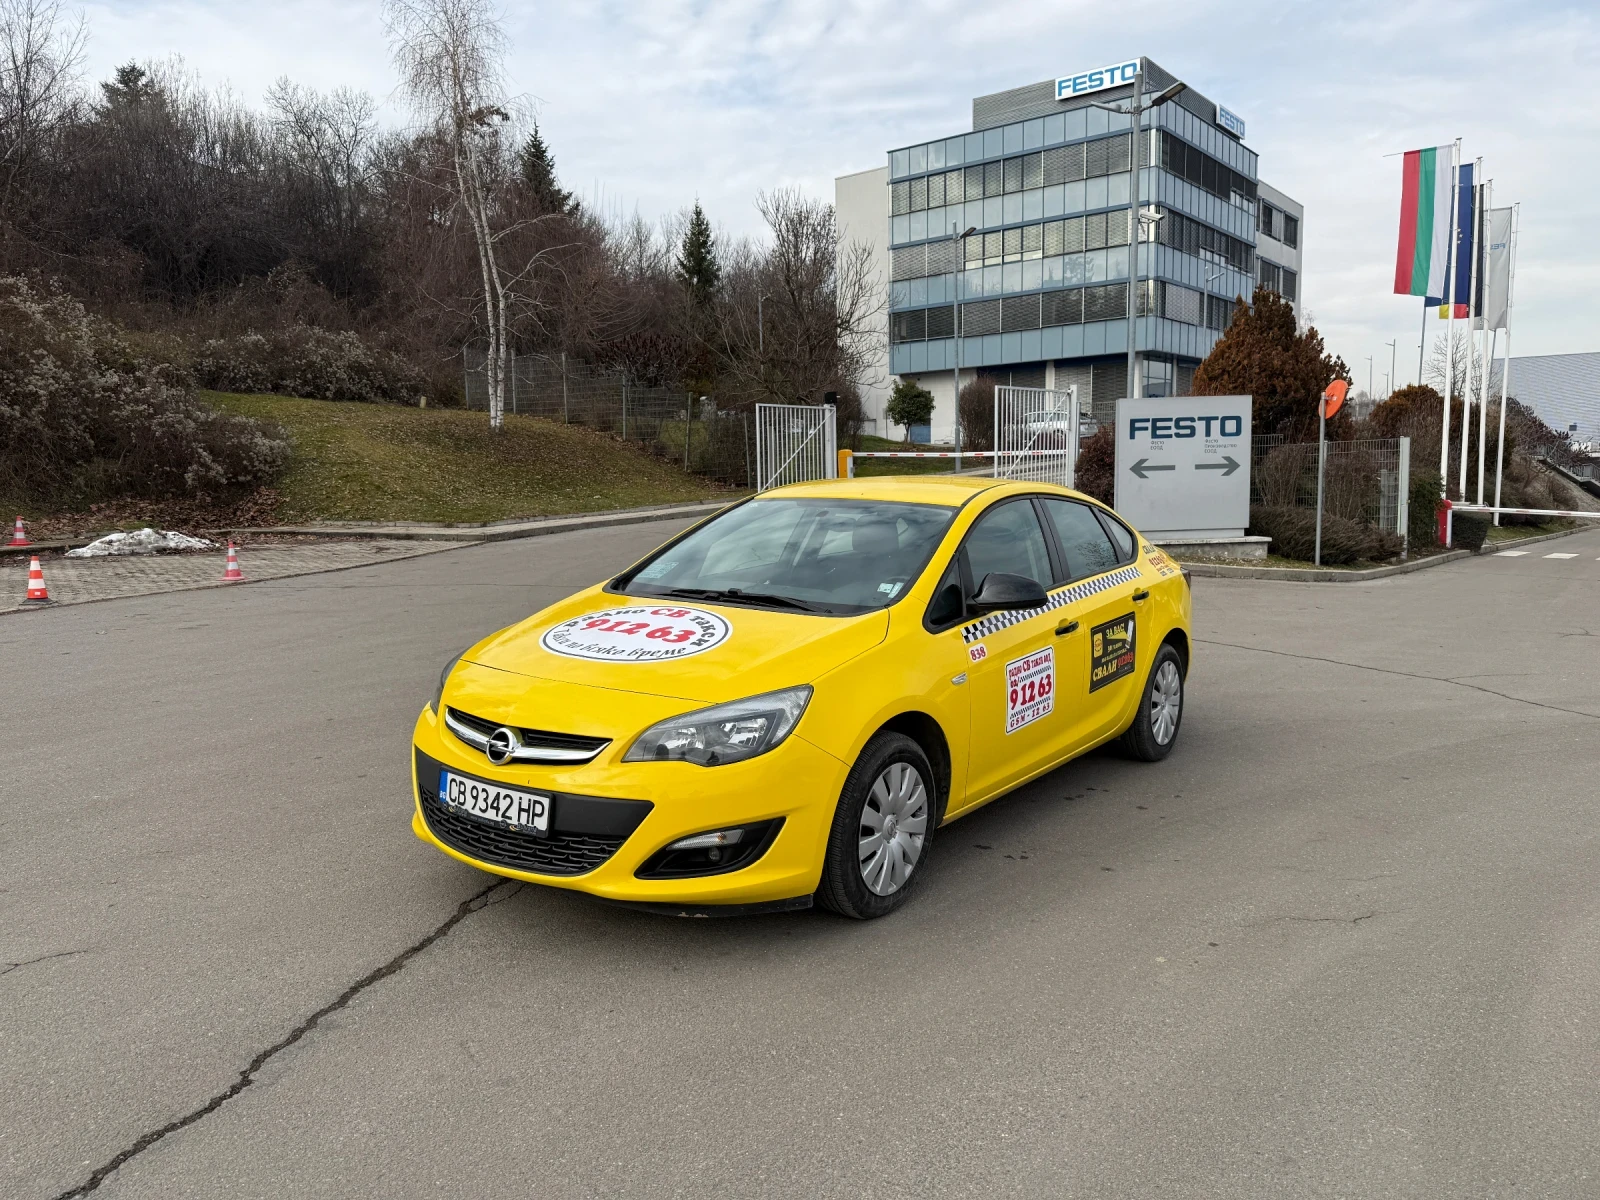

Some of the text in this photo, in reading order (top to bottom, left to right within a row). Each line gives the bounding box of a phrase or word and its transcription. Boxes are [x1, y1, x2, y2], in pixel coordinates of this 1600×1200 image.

[1057, 62, 1138, 97] FESTO
[1219, 108, 1245, 137] FESTO
[1129, 415, 1242, 440] FESTO
[970, 646, 986, 661] 838
[1020, 680, 1036, 706] 12
[1038, 673, 1052, 698] 63
[449, 777, 467, 807] CB
[470, 785, 514, 821] 9342
[517, 796, 545, 826] HP
